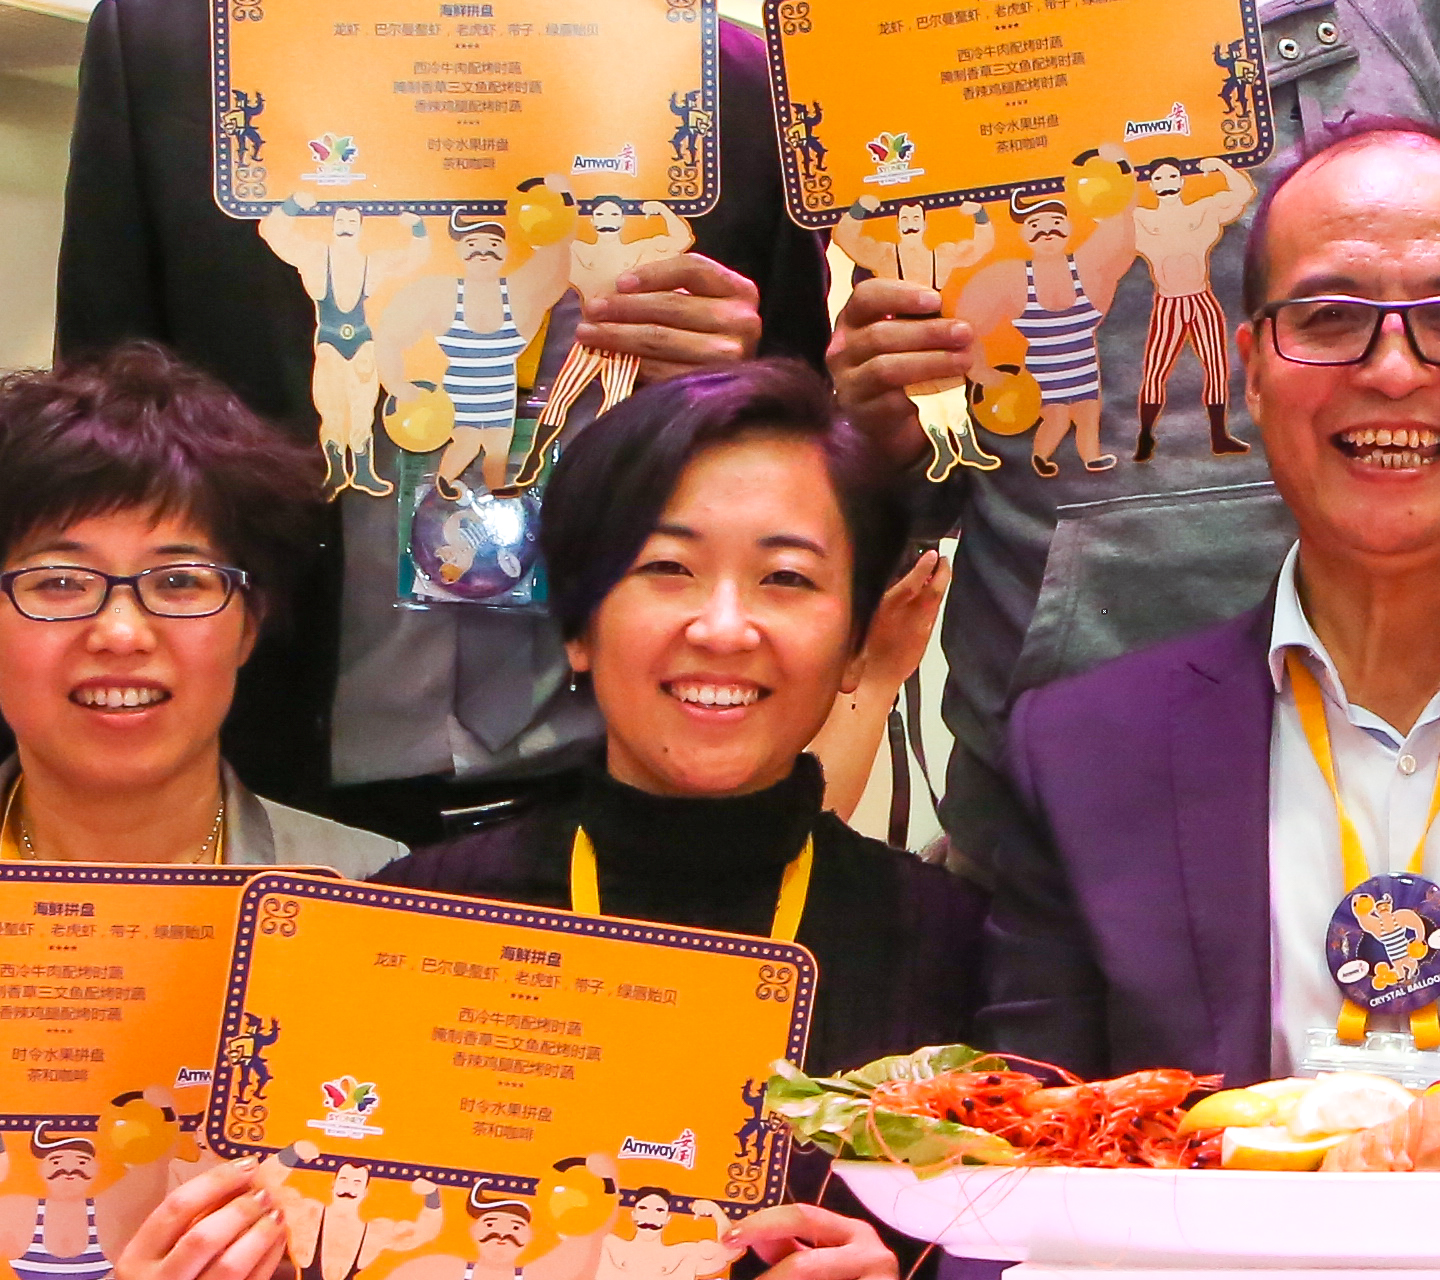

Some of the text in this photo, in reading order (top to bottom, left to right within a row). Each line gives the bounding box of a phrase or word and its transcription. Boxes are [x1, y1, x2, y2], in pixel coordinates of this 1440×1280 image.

[980, 113, 1060, 140] 时令水果拼盘
[1125, 116, 1172, 139] Amway
[573, 155, 621, 172] Amway
[1369, 989, 1407, 1008] CRYSTAL
[178, 1069, 212, 1082] Amw
[621, 1138, 678, 1160] Amway
